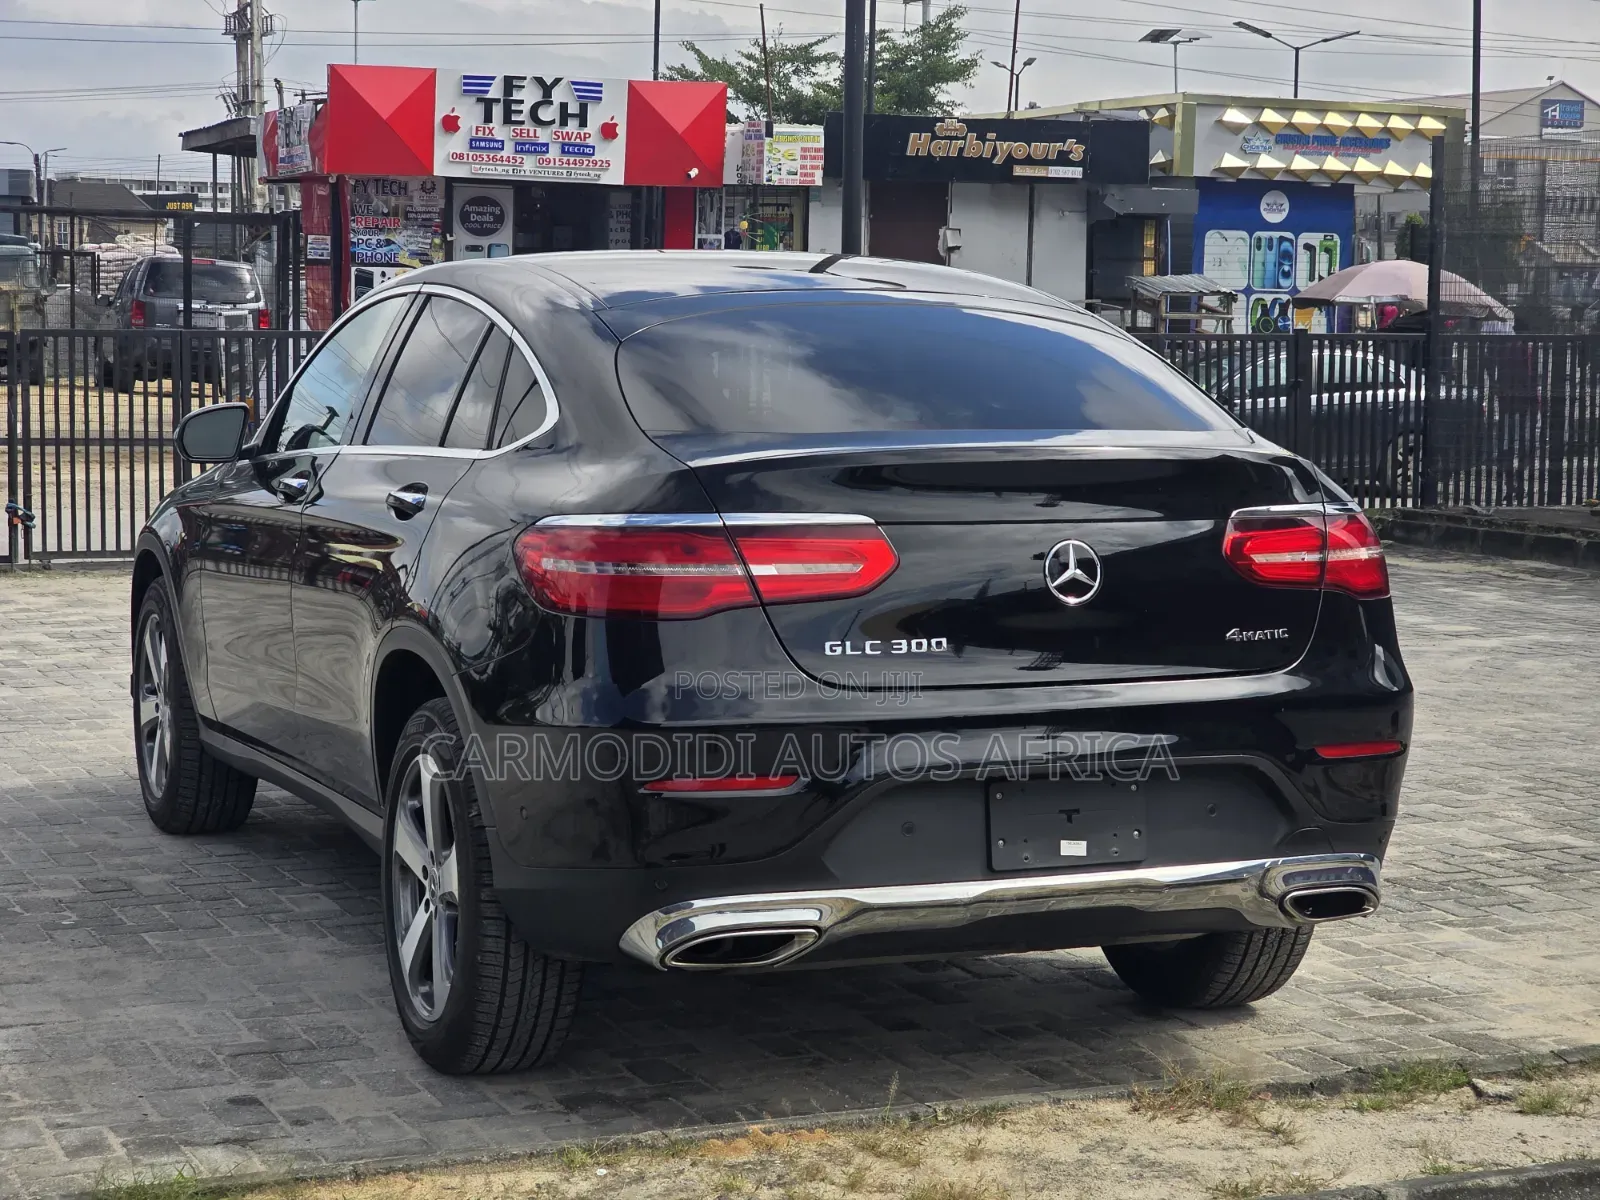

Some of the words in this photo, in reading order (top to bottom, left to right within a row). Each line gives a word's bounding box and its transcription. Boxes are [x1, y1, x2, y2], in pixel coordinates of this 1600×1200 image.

[503, 75, 564, 99] FY
[476, 97, 589, 128] TECH
[1560, 103, 1580, 111] travel
[474, 125, 496, 137] FIX
[511, 127, 540, 139] SELL
[552, 130, 592, 142] SWAP
[471, 140, 503, 149] SAMSUNG
[516, 144, 548, 153] Infinix
[564, 146, 593, 154] TECNO
[906, 133, 1086, 164] Harbiyour's
[451, 152, 525, 165] 08105364452
[537, 157, 611, 168] 09154492925
[528, 169, 565, 177] VENTURES
[353, 179, 370, 195] FY
[374, 179, 408, 198] TECH
[166, 202, 180, 210] JUST
[181, 202, 193, 210] ASK
[355, 204, 373, 215] WE
[464, 205, 501, 214] Amazing
[355, 216, 401, 228] REPAIR
[470, 213, 494, 221] Deals
[356, 229, 380, 237] YOUR
[356, 238, 373, 249] PC
[376, 238, 385, 249] &
[356, 252, 400, 263] PHONE
[1225, 628, 1289, 641] 4MATIC
[824, 641, 882, 655] GLC
[891, 638, 947, 654] 300
